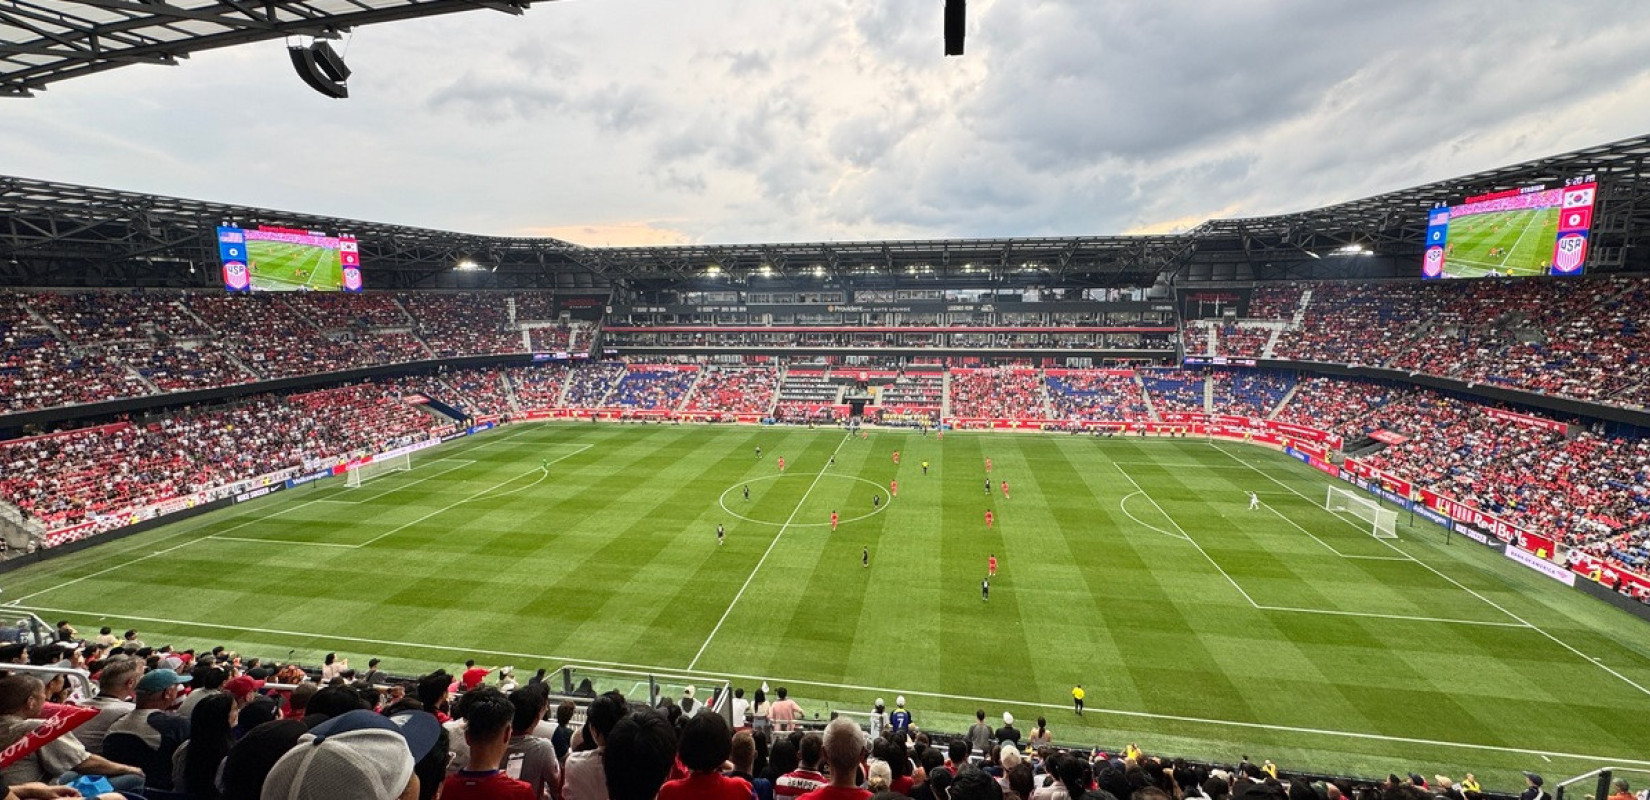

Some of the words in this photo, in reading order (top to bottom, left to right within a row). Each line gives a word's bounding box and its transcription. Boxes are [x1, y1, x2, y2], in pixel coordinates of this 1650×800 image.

[1561, 239, 1581, 252] USA
[293, 470, 329, 485] Volkswagen
[1412, 502, 1447, 527] olkswagen
[1510, 551, 1524, 560] BANK
[1531, 560, 1556, 575] AMERICA
[896, 718, 905, 728] 7
